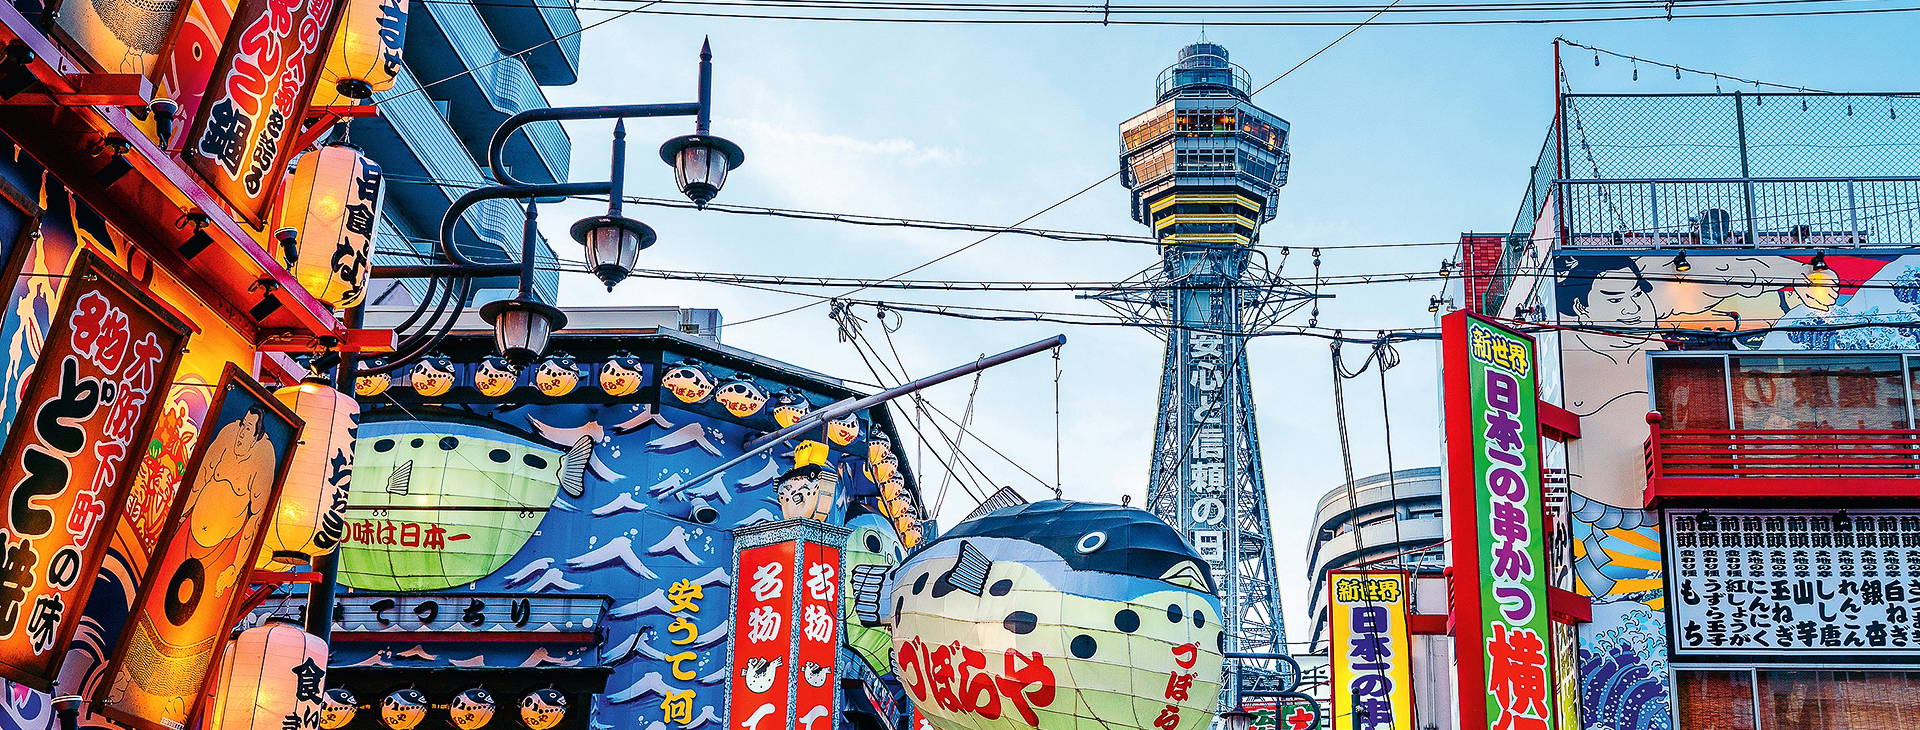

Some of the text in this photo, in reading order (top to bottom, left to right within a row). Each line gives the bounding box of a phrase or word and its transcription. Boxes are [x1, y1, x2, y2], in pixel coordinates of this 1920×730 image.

[71, 292, 130, 371] 名物
[1471, 328, 1529, 376] 新世界
[33, 335, 163, 653] 大阪下町の味
[749, 562, 783, 643] 名物
[805, 562, 835, 643] 名物
[1337, 580, 1401, 602] 新世界
[1681, 579, 1703, 647] もち
[1724, 579, 1751, 647] 紅しょうが
[1747, 580, 1771, 647] にんにく
[1770, 580, 1796, 647] 玉ねぎ
[1793, 580, 1818, 647] 山芋
[1838, 579, 1865, 647] れんこん
[1885, 580, 1910, 647] 白ねぎ
[660, 578, 704, 725] 安うて何
[899, 635, 1056, 728] づぼらや
